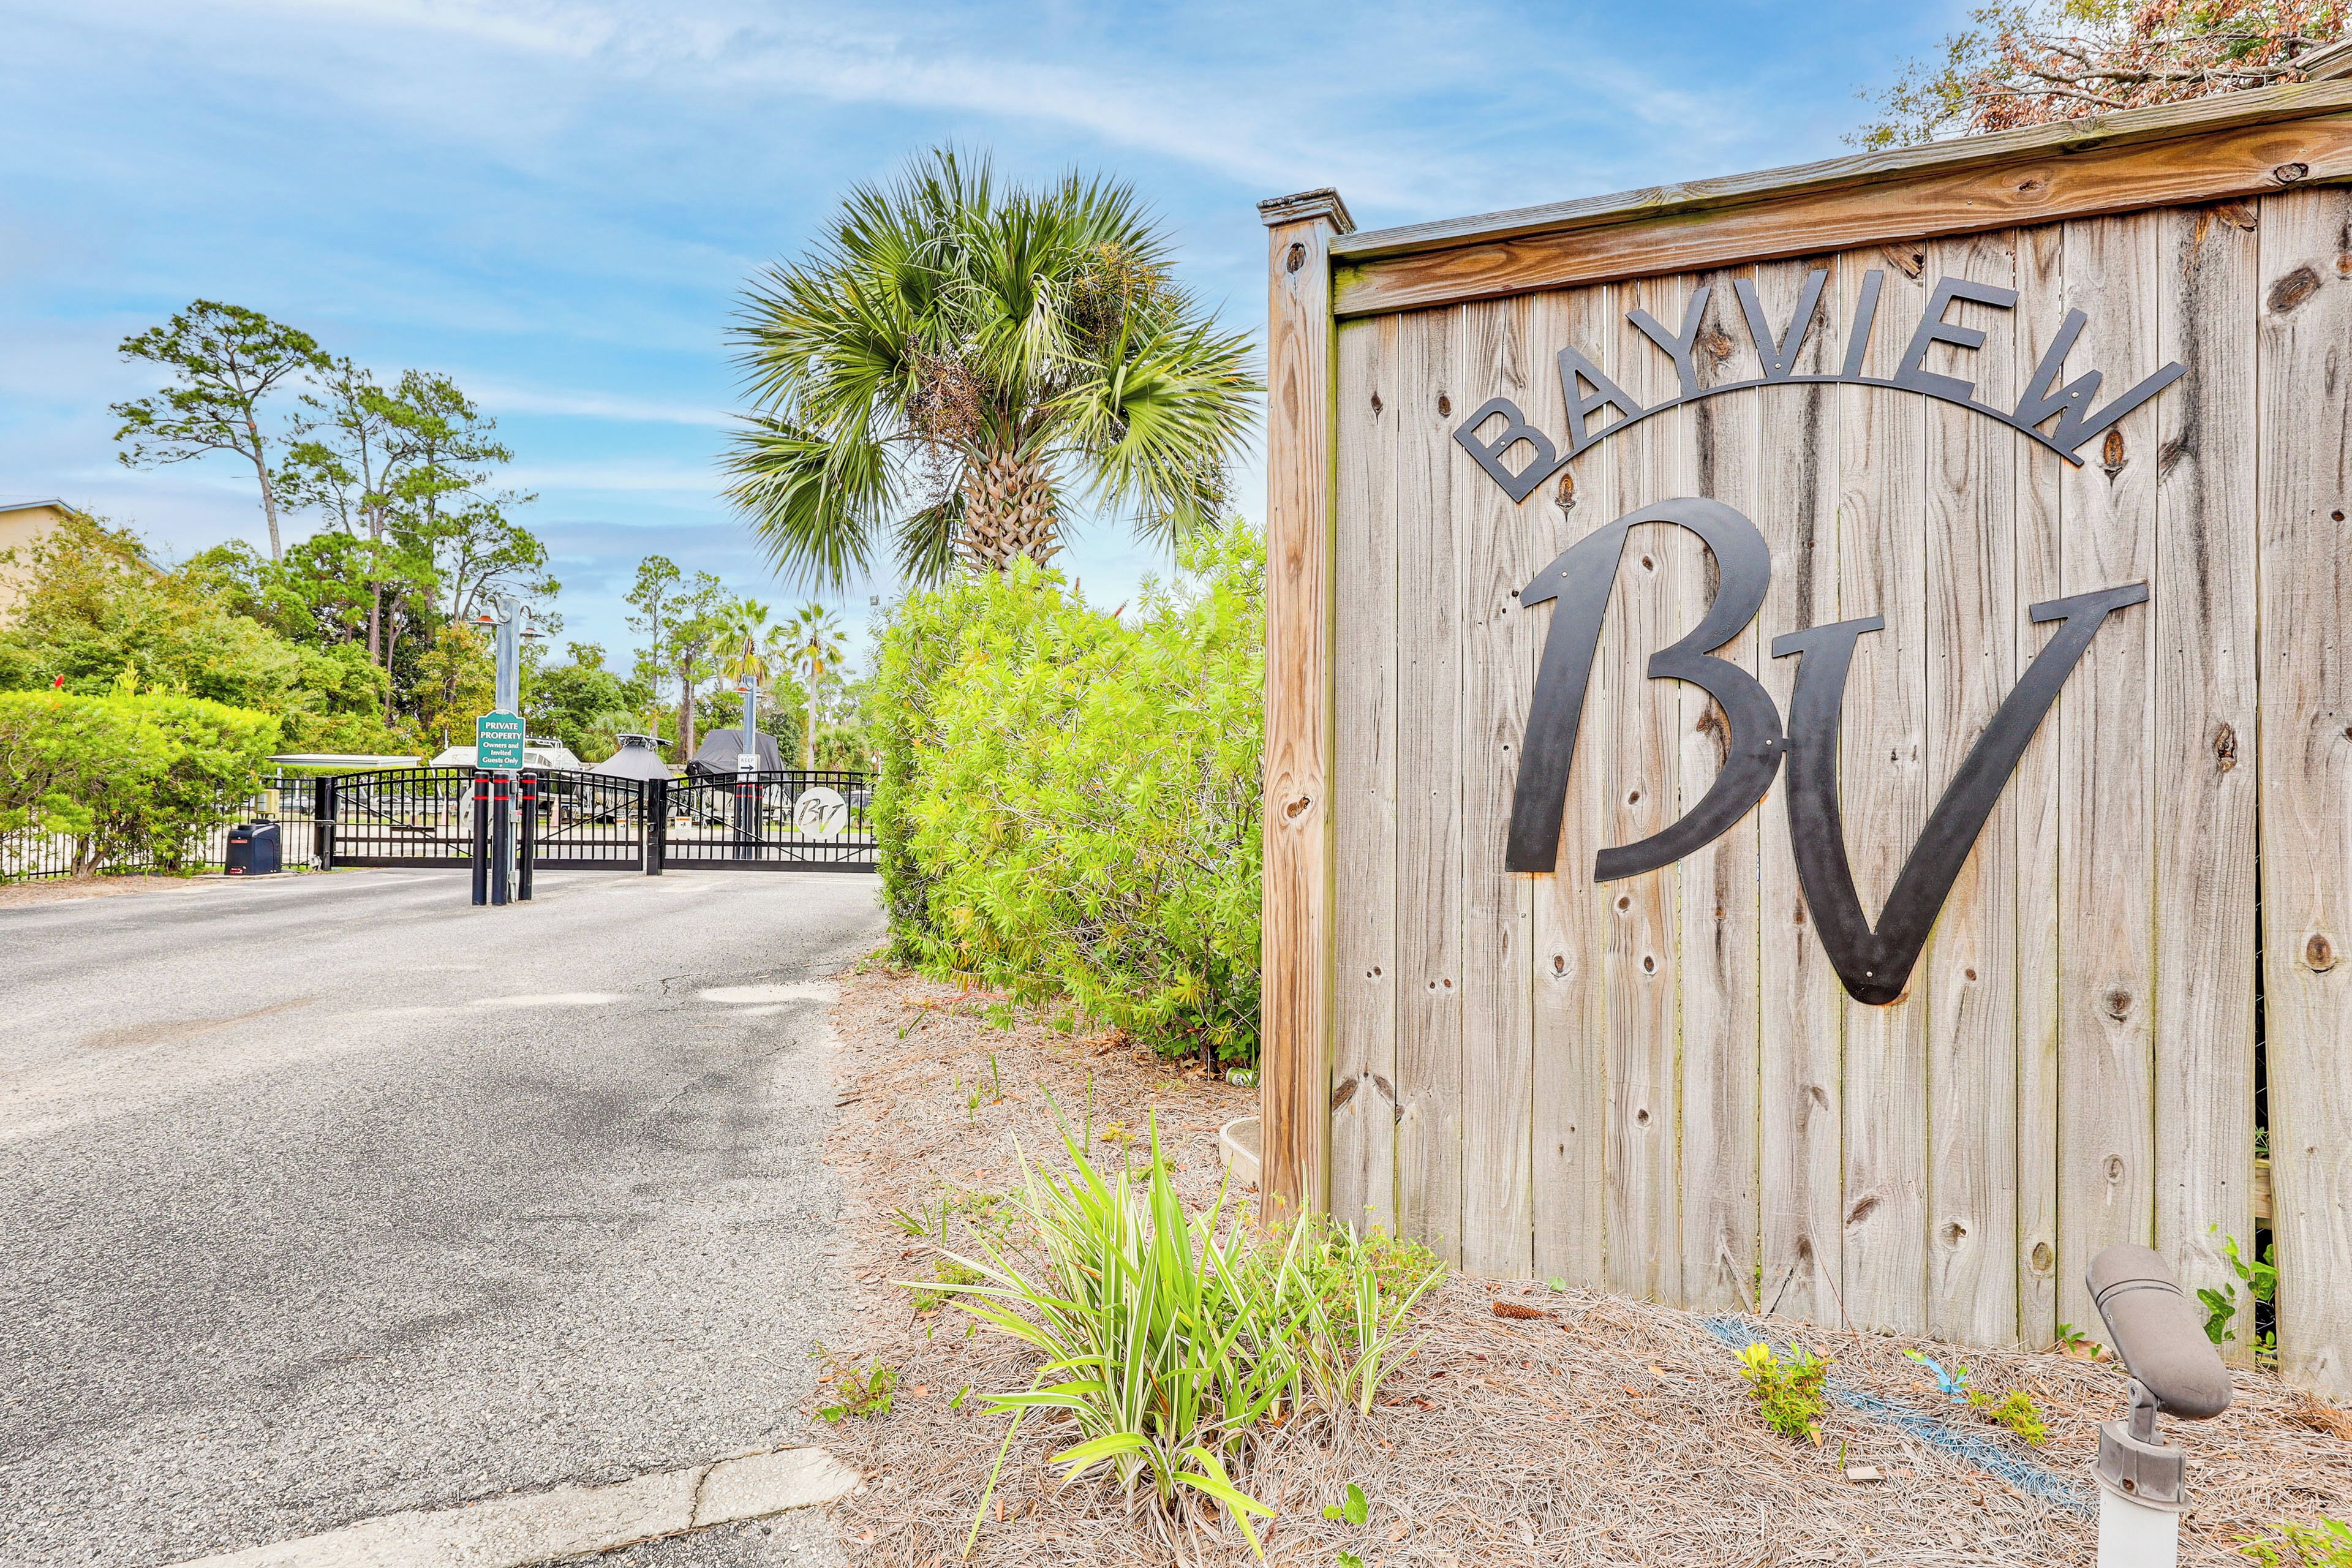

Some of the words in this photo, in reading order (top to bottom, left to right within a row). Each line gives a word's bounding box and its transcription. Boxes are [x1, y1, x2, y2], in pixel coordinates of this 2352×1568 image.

[1453, 268, 2188, 502] BAYVIEW
[797, 798, 844, 834] BV
[1506, 497, 2150, 1005] BV
